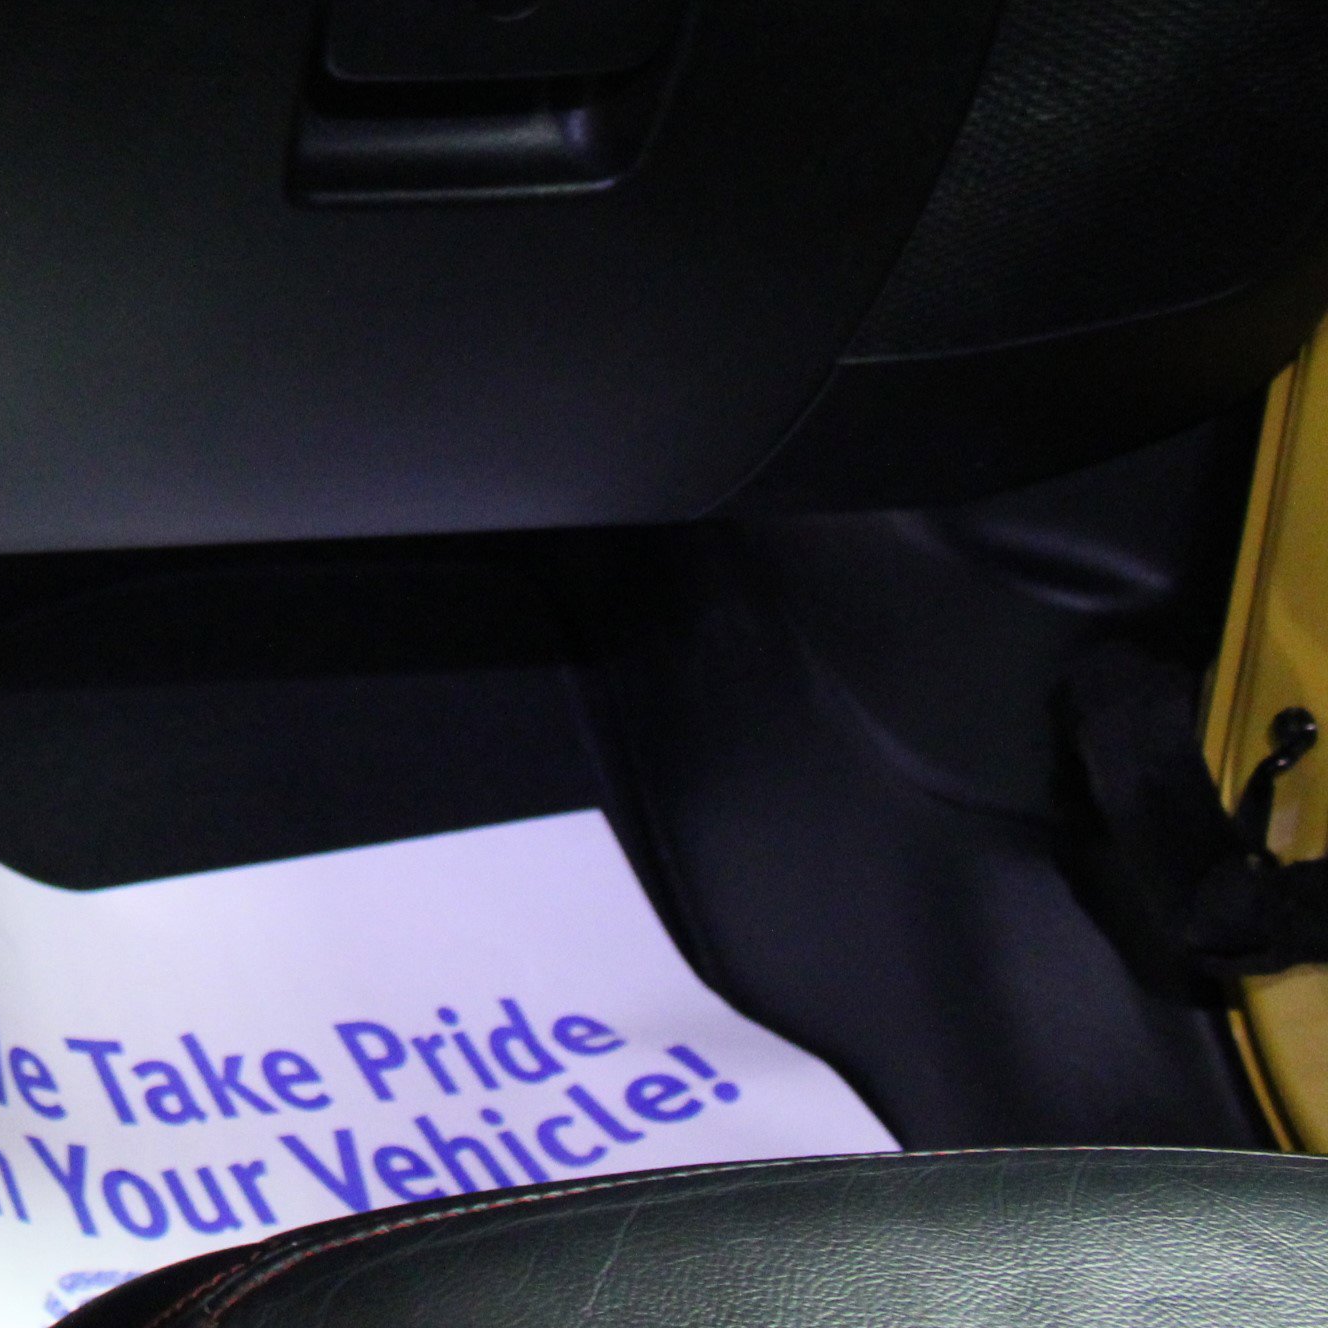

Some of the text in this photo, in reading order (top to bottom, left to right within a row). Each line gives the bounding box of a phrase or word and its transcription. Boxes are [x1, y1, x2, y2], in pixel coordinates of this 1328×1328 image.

[25, 1134, 274, 1241] Your
[278, 1044, 741, 1214] Vehicle!
[65, 1032, 334, 1127] Take
[333, 998, 628, 1103] Pride
